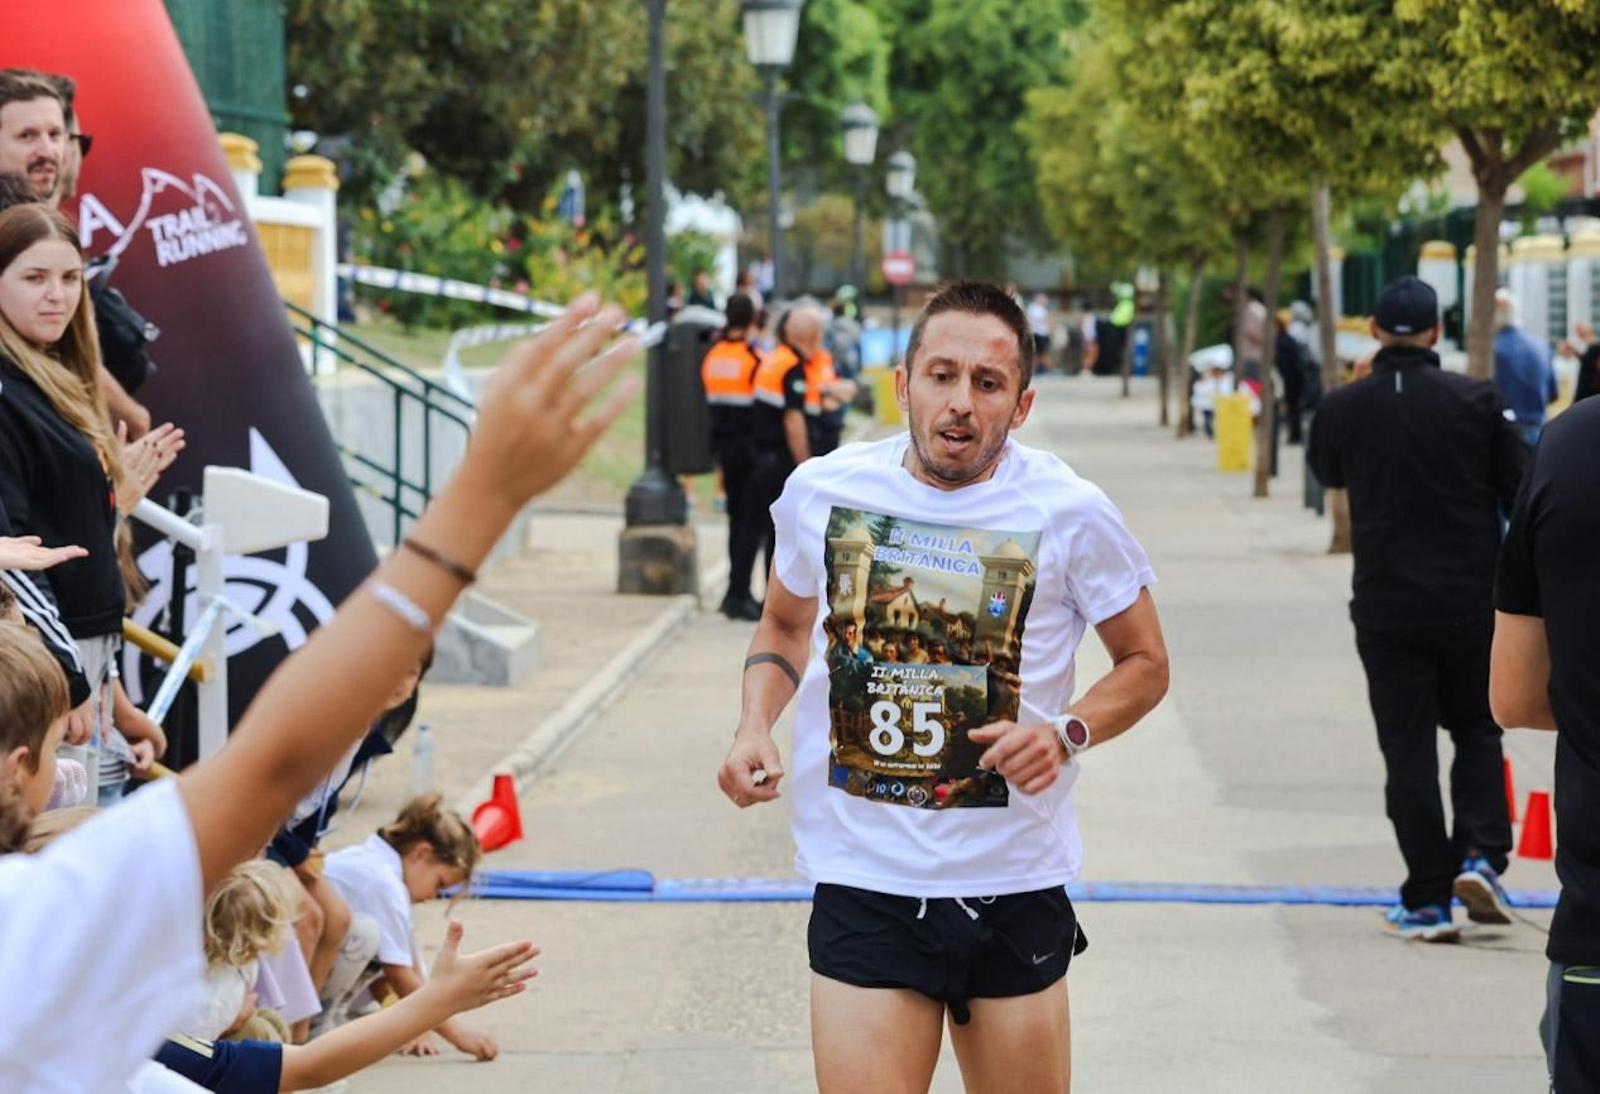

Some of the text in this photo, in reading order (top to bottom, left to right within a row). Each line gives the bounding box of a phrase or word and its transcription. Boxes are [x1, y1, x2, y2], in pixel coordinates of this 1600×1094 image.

[145, 205, 212, 242] TRAIL
[155, 219, 248, 267] RUNNING
[909, 533, 974, 555] MILLA
[871, 666, 939, 680] II MILLA
[869, 700, 946, 757] 85
